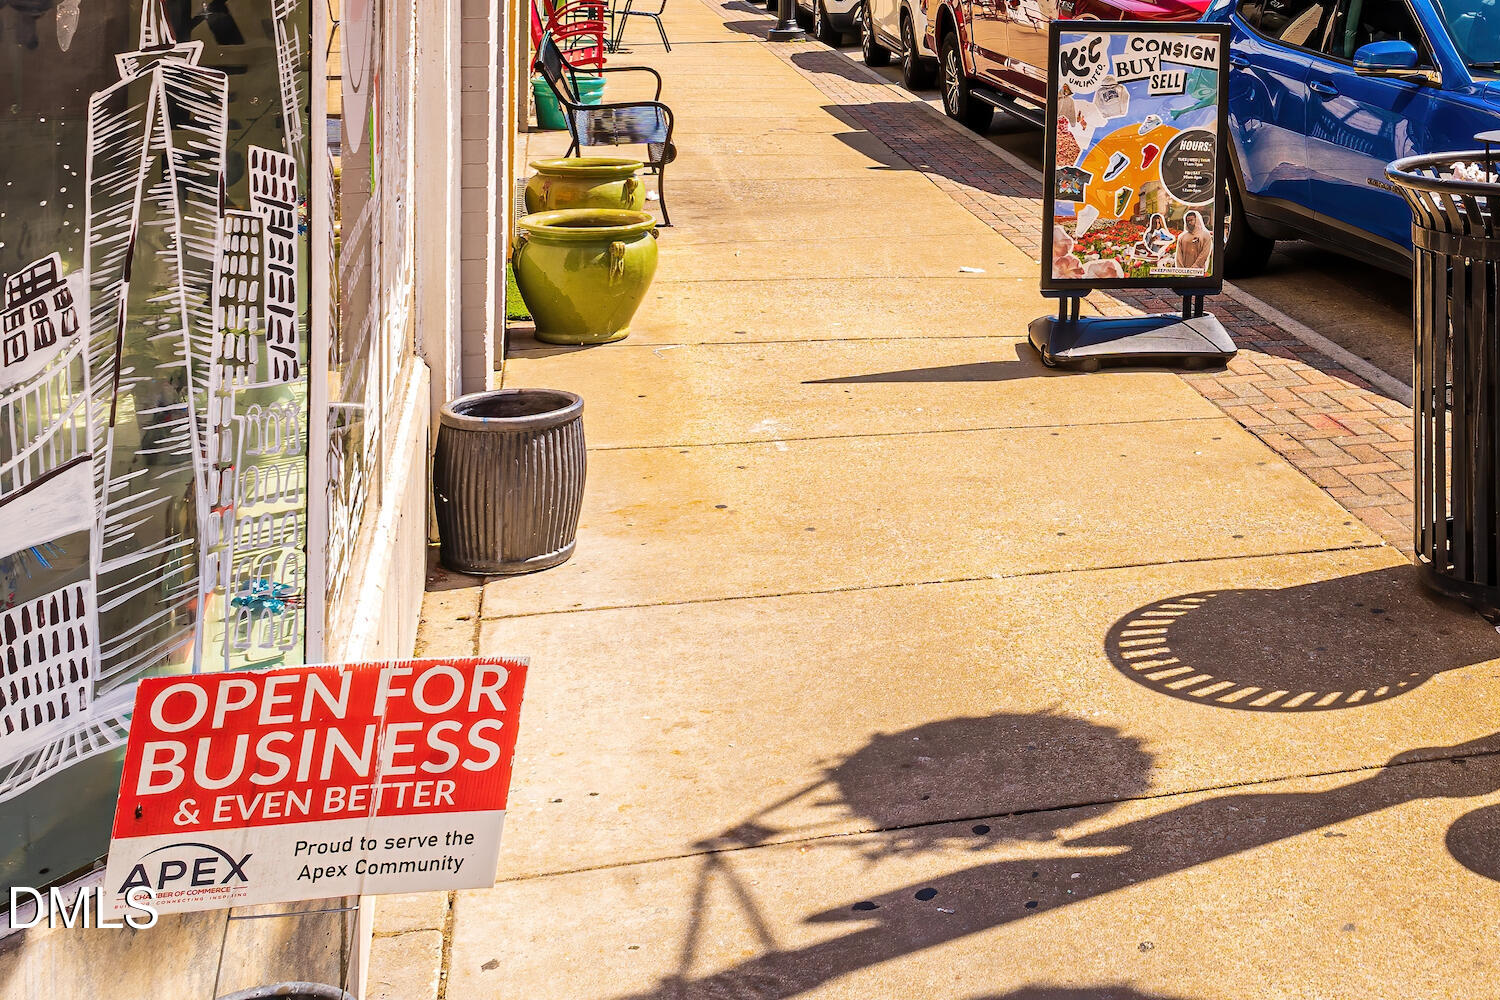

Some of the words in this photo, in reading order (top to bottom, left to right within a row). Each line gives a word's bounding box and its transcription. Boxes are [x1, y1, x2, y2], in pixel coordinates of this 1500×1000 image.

[1116, 57, 1157, 78] BUY
[1151, 73, 1180, 90] SELL
[1180, 140, 1212, 152] HOURS:
[149, 670, 353, 734] OPEN
[373, 664, 510, 717] FOR
[135, 718, 504, 797] BUSINESS
[173, 798, 201, 826] &
[212, 793, 312, 824] EVEN
[322, 779, 456, 815] BETTER
[294, 835, 353, 857] Proud
[360, 836, 377, 852] to
[383, 836, 438, 850] serve
[445, 830, 475, 847] the
[117, 853, 253, 894] APEX
[297, 864, 348, 883] Apex
[354, 855, 465, 878] Community
[156, 897, 204, 905] CONNECTING
[187, 886, 231, 895] COMMERCE
